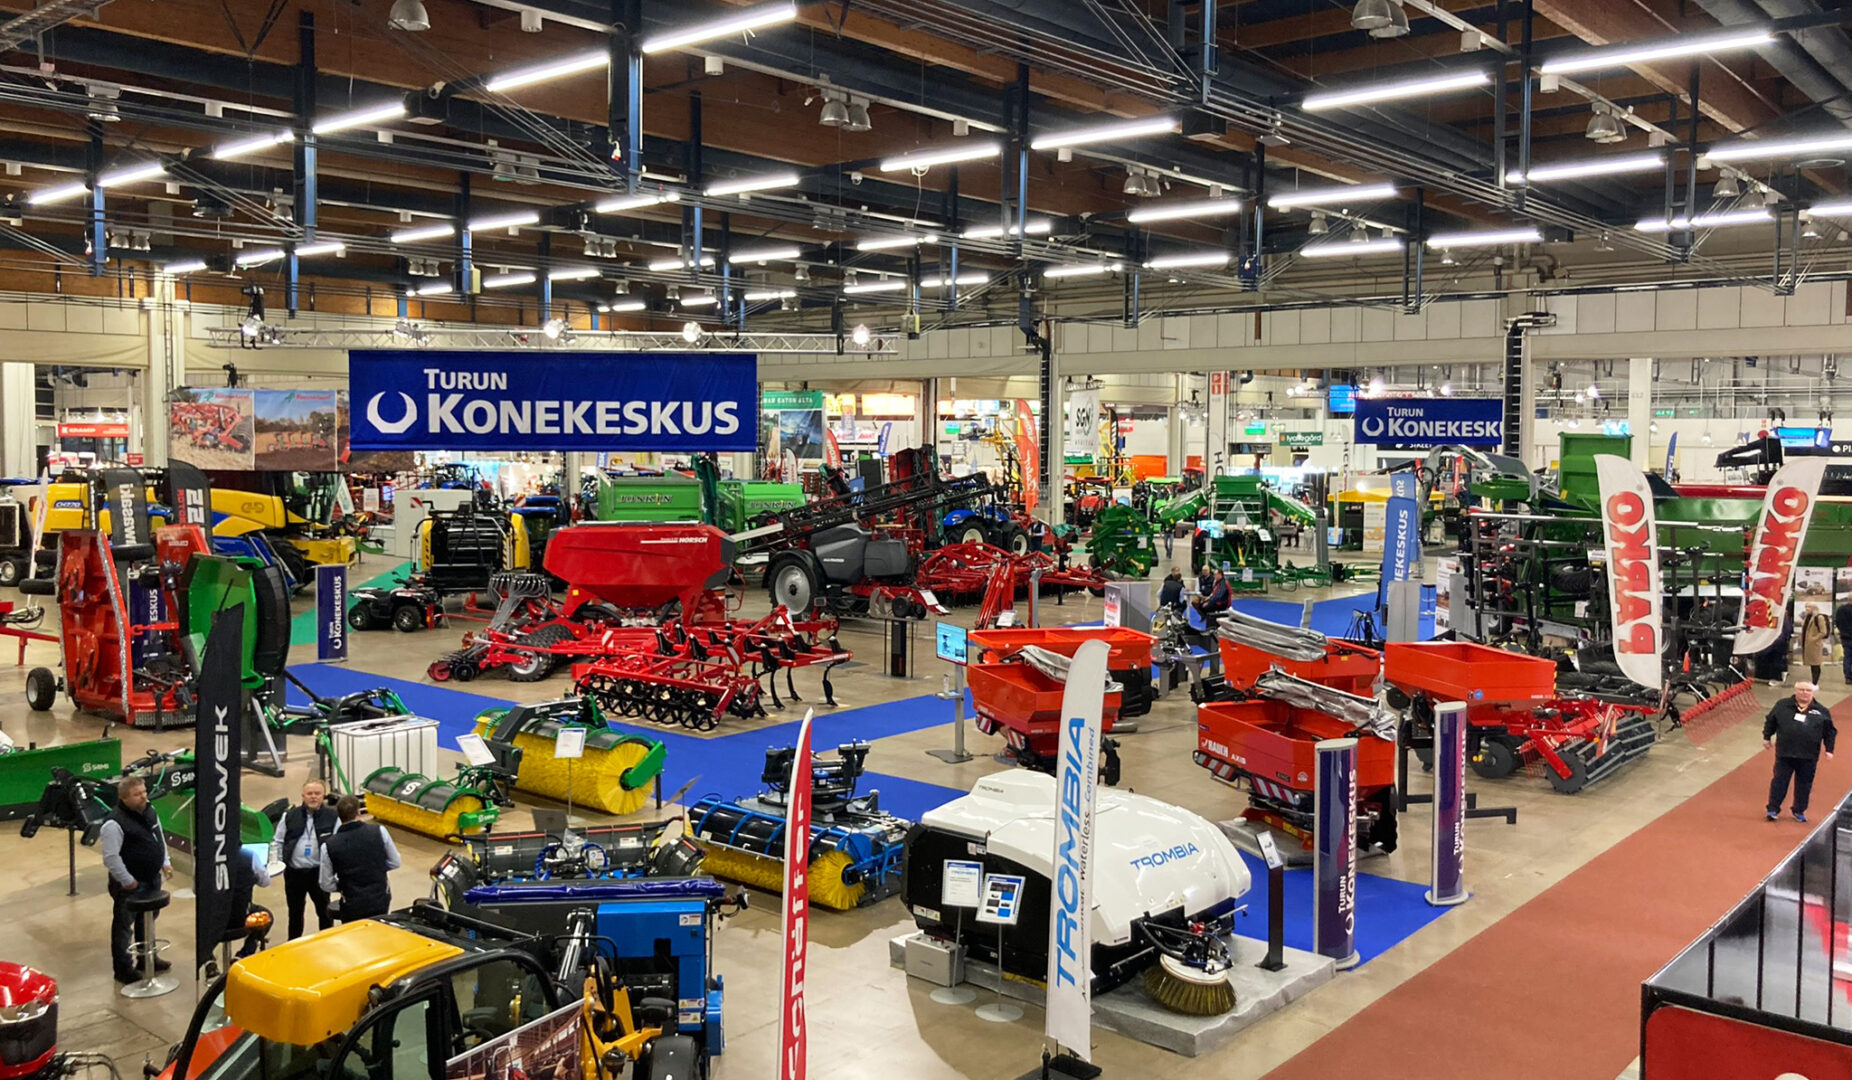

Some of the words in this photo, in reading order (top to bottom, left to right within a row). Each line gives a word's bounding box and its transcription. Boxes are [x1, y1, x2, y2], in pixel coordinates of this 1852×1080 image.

[424, 368, 507, 390] TURUN
[428, 393, 740, 435] KONEKESKUS
[1387, 407, 1424, 417] TURUN
[1388, 418, 1503, 437] KONEKESK
[1745, 487, 1809, 629] PARKO
[333, 576, 342, 637] KONEKESKUS
[214, 704, 230, 890] SNOWEK
[1056, 718, 1086, 988] TROMBIA
[1130, 842, 1199, 870] TROMBIA
[1346, 769, 1357, 909] KONEKESKUS
[1338, 876, 1346, 914] TURUN
